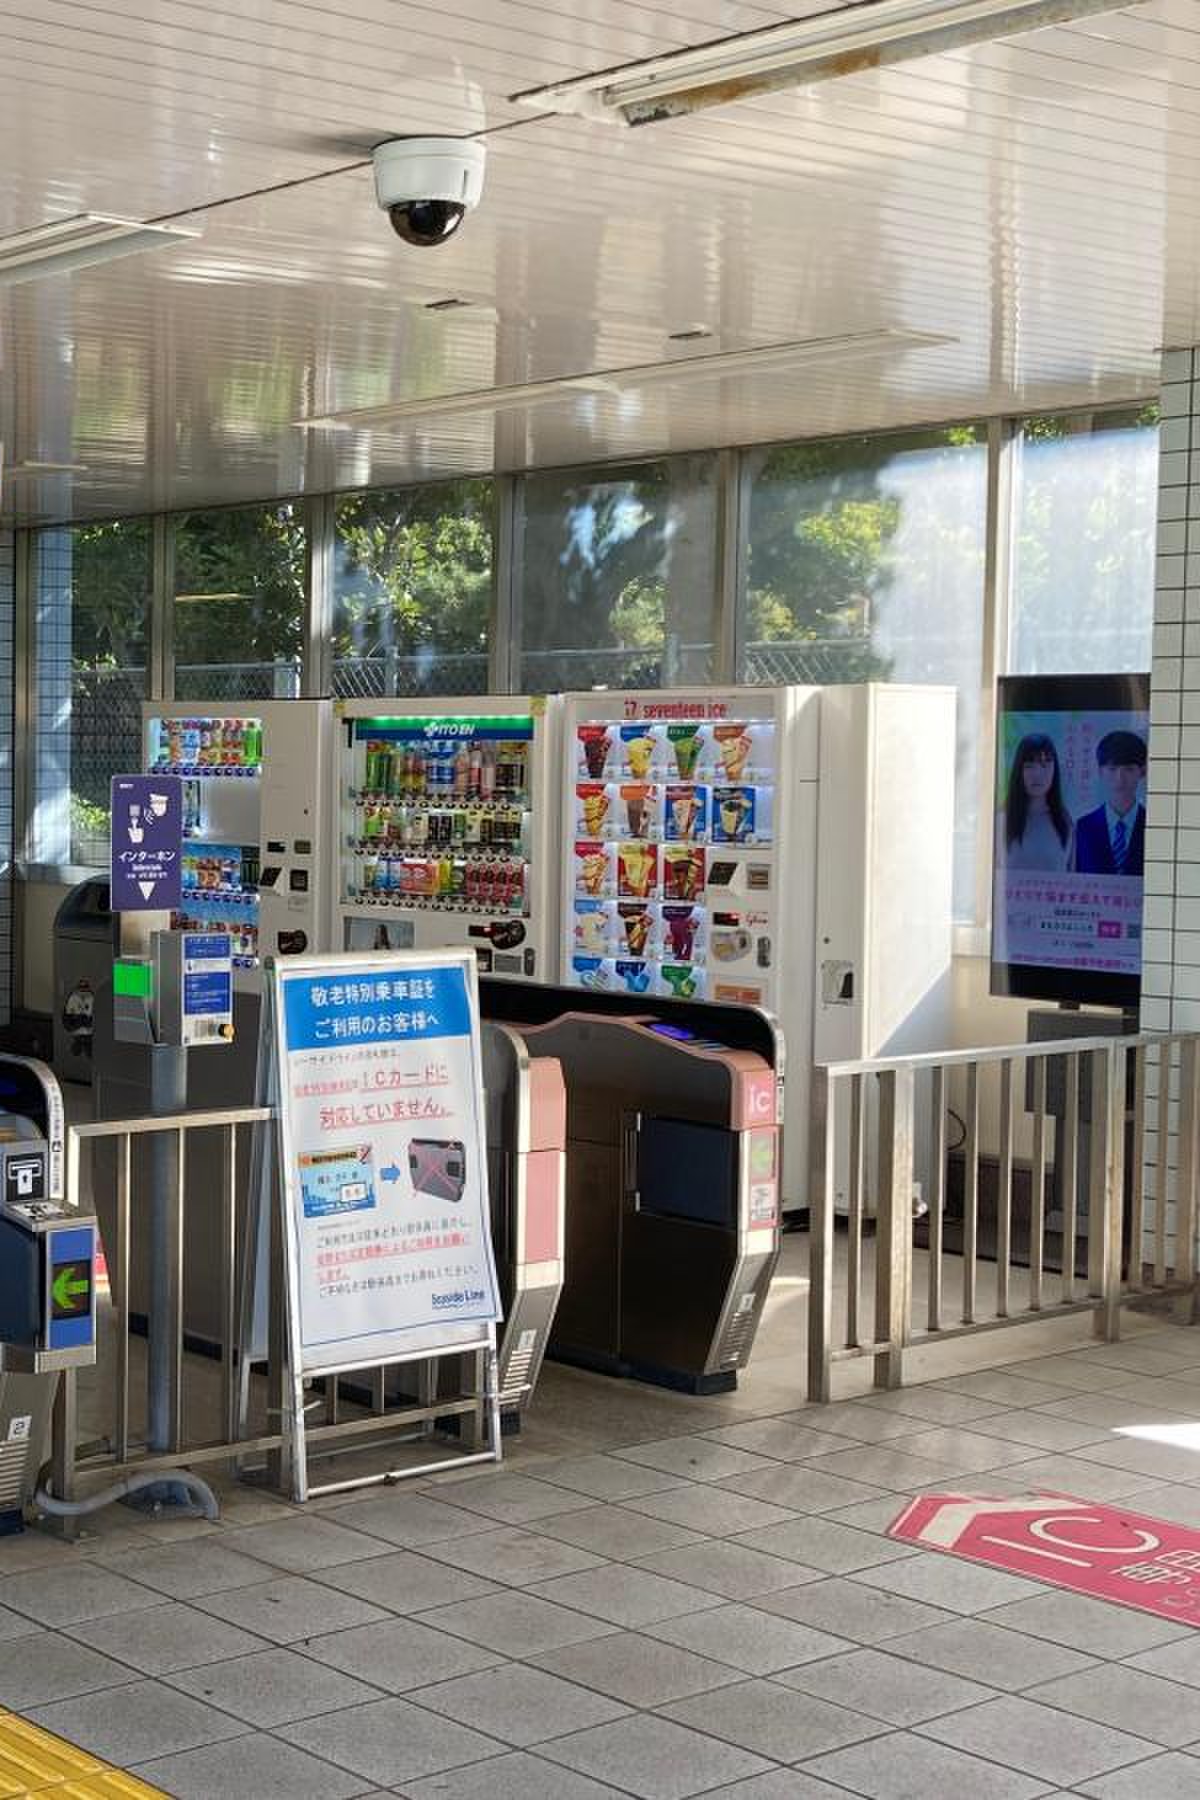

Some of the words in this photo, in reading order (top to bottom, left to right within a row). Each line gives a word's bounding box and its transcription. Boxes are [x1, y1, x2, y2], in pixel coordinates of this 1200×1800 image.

[643, 700, 704, 718] seventeen
[707, 699, 727, 718] ice
[119, 850, 176, 863] インターホン
[310, 979, 436, 1008] 敬老特別乗車証を
[315, 1010, 441, 1040] ご利用のお客様へ
[979, 1515, 1161, 1569] IC
